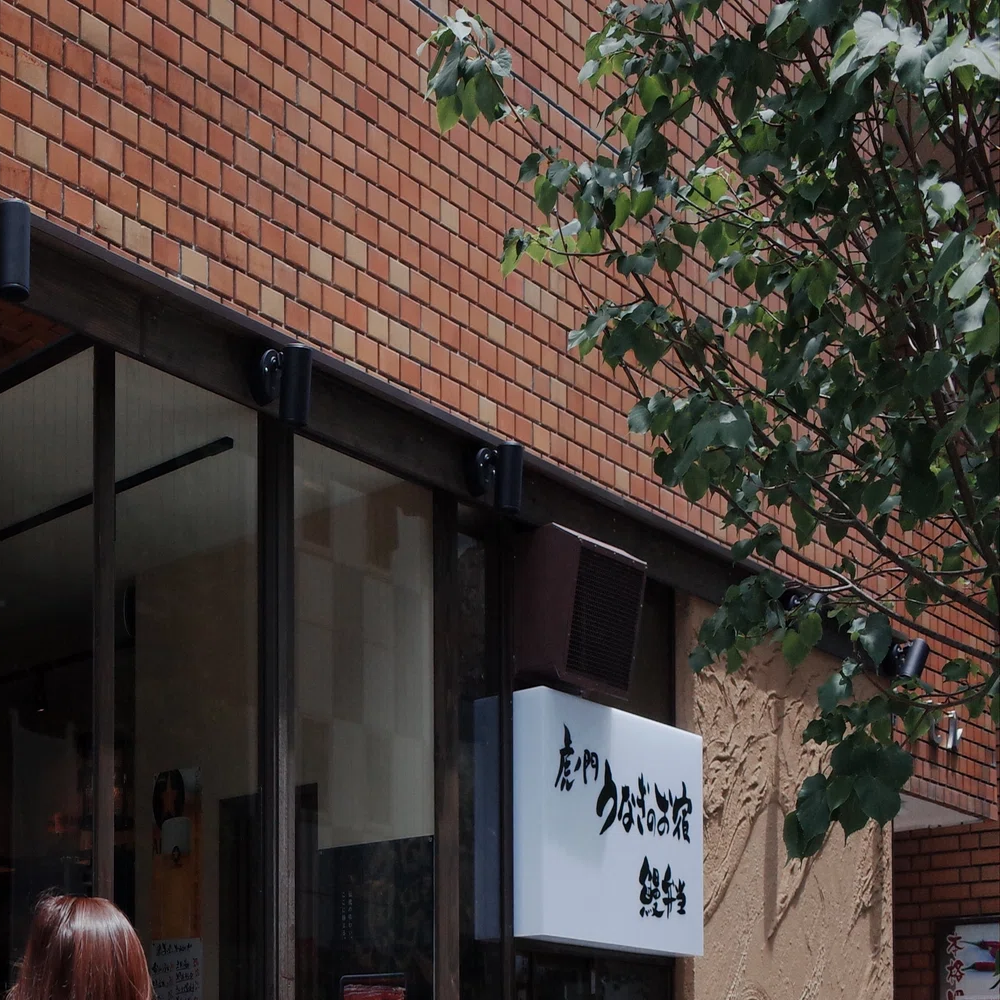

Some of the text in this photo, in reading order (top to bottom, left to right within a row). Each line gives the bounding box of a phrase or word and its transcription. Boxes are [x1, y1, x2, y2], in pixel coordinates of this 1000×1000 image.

[555, 723, 599, 791] 虎ノ門
[596, 758, 692, 844] うなぎのお宿
[639, 856, 686, 919] 鰻弁当
